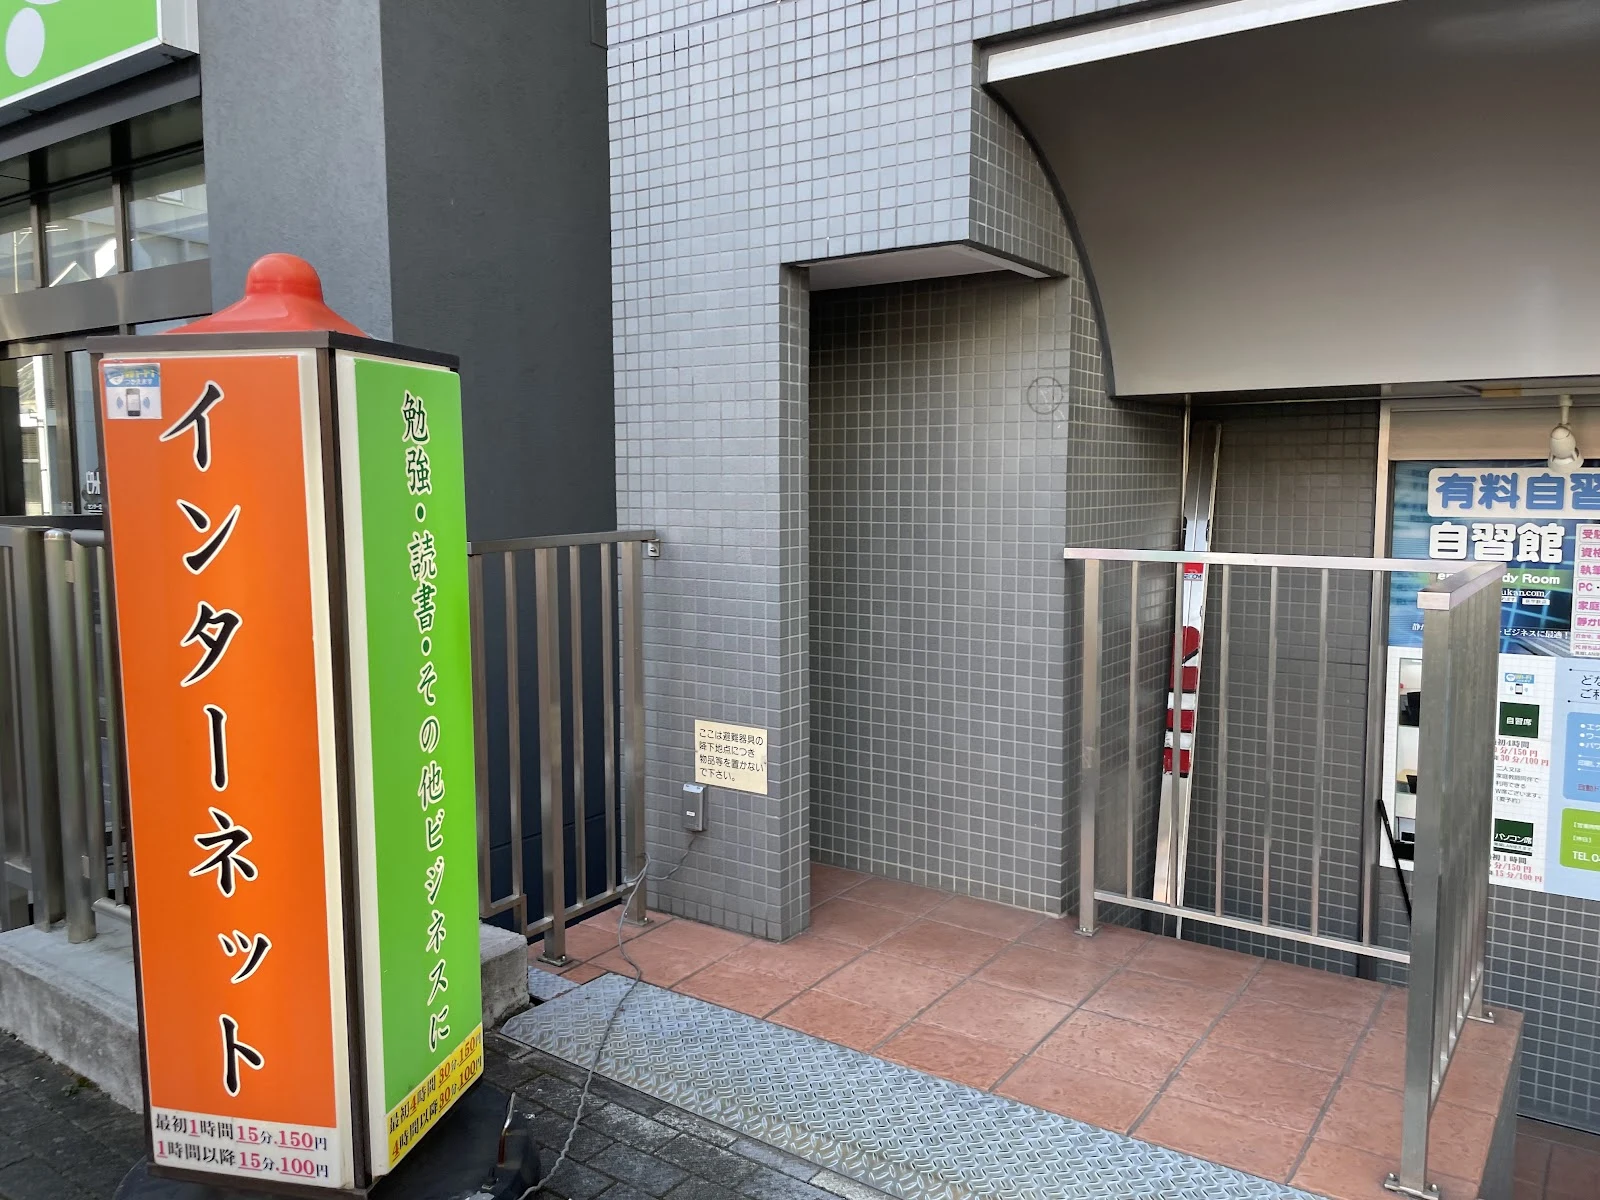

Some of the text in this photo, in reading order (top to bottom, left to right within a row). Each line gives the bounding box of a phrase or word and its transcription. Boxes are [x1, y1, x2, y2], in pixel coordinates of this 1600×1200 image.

[1435, 472, 1600, 510] 有料自習
[1428, 521, 1565, 563] 自習館
[1522, 574, 1560, 584] Room
[401, 389, 452, 1053] 勉強・読書・その他ビジネスに
[1506, 716, 1533, 726] 自習席
[158, 379, 272, 1099] インターネット
[700, 728, 764, 746] ここは避難器具の
[1495, 738, 1530, 749] 初4時間
[699, 741, 756, 758] 降下地点につき
[699, 755, 764, 772] 物品等を置かない
[700, 767, 736, 782] で下さい。
[1572, 850, 1590, 861] TEL
